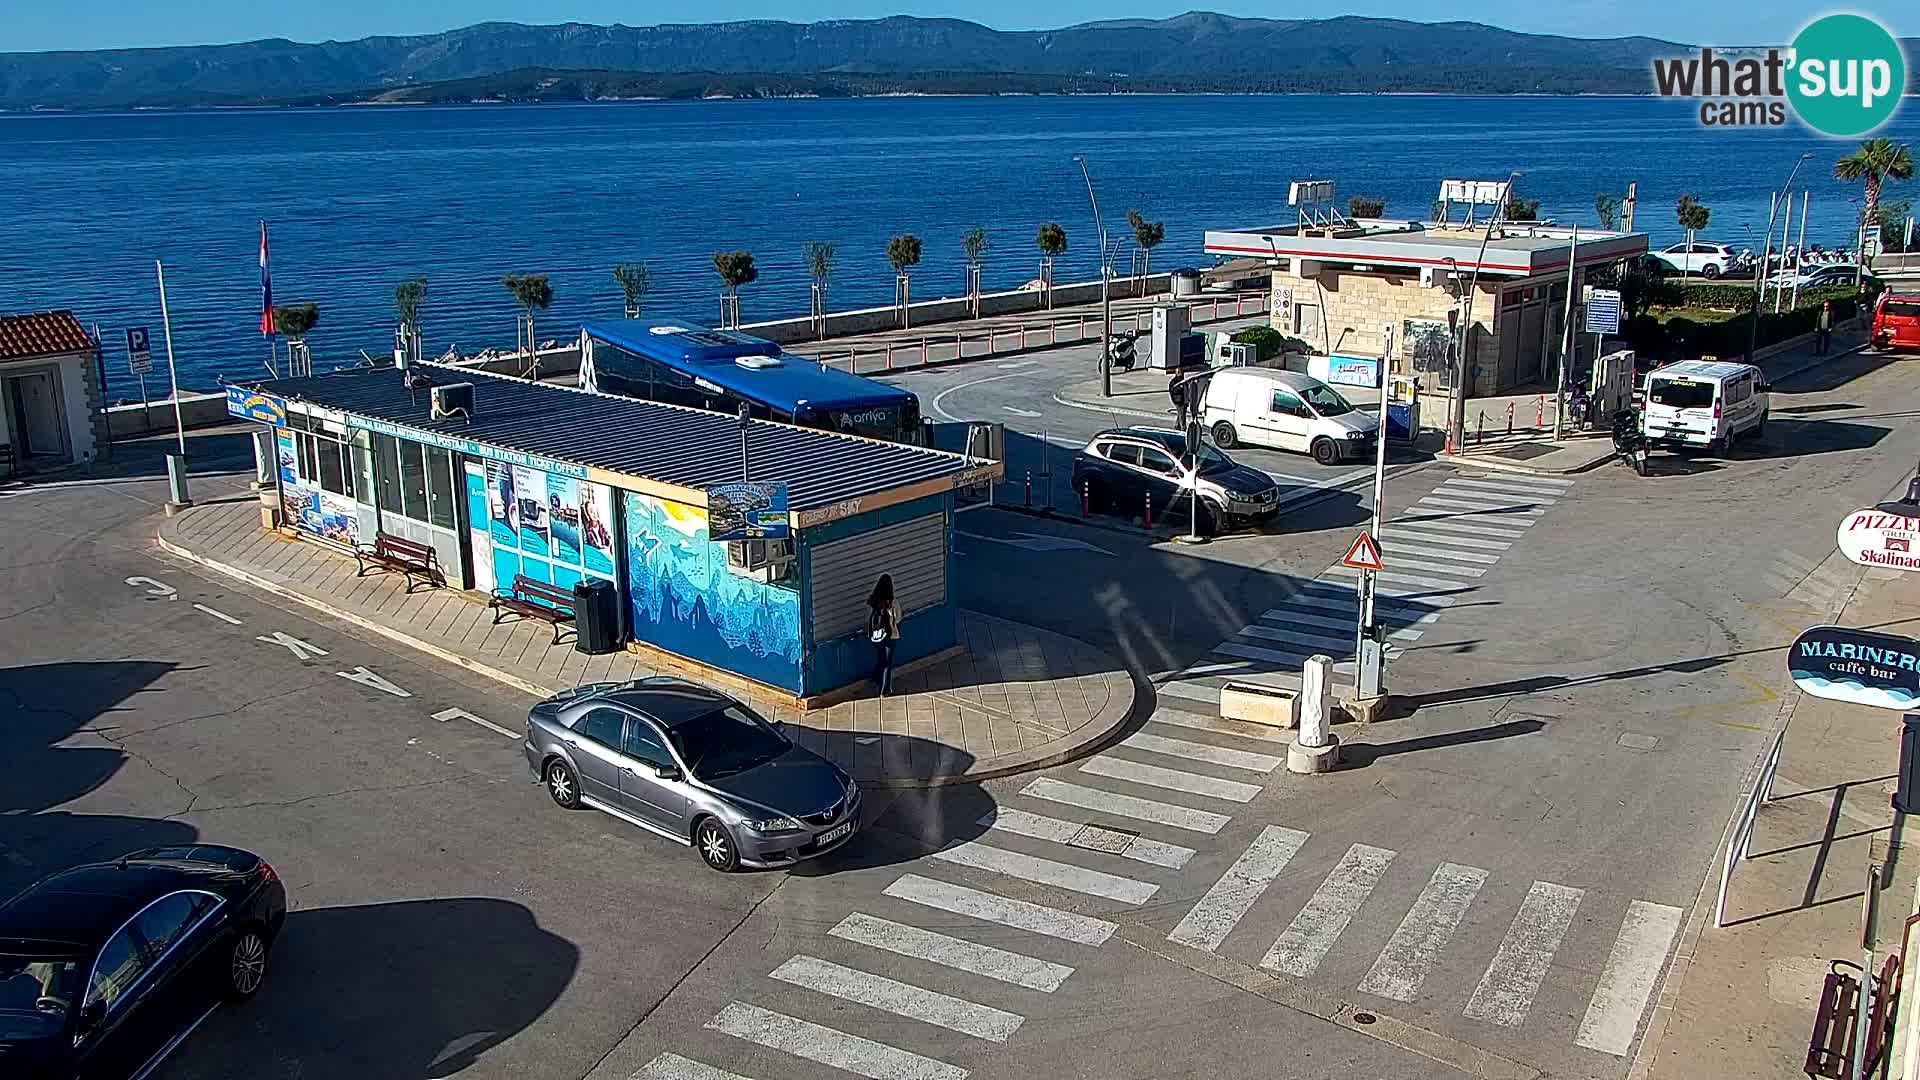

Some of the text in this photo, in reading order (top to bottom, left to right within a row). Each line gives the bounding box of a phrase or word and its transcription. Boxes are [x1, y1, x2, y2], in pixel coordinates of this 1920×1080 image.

[132, 331, 144, 348] P
[854, 410, 886, 424] arriva
[479, 444, 494, 457] BUS
[495, 448, 528, 464] STATION
[529, 456, 556, 471] TICKET
[556, 462, 584, 476] OFFICE
[1881, 530, 1917, 540] GRILL
[1829, 661, 1897, 680] caffe bar
